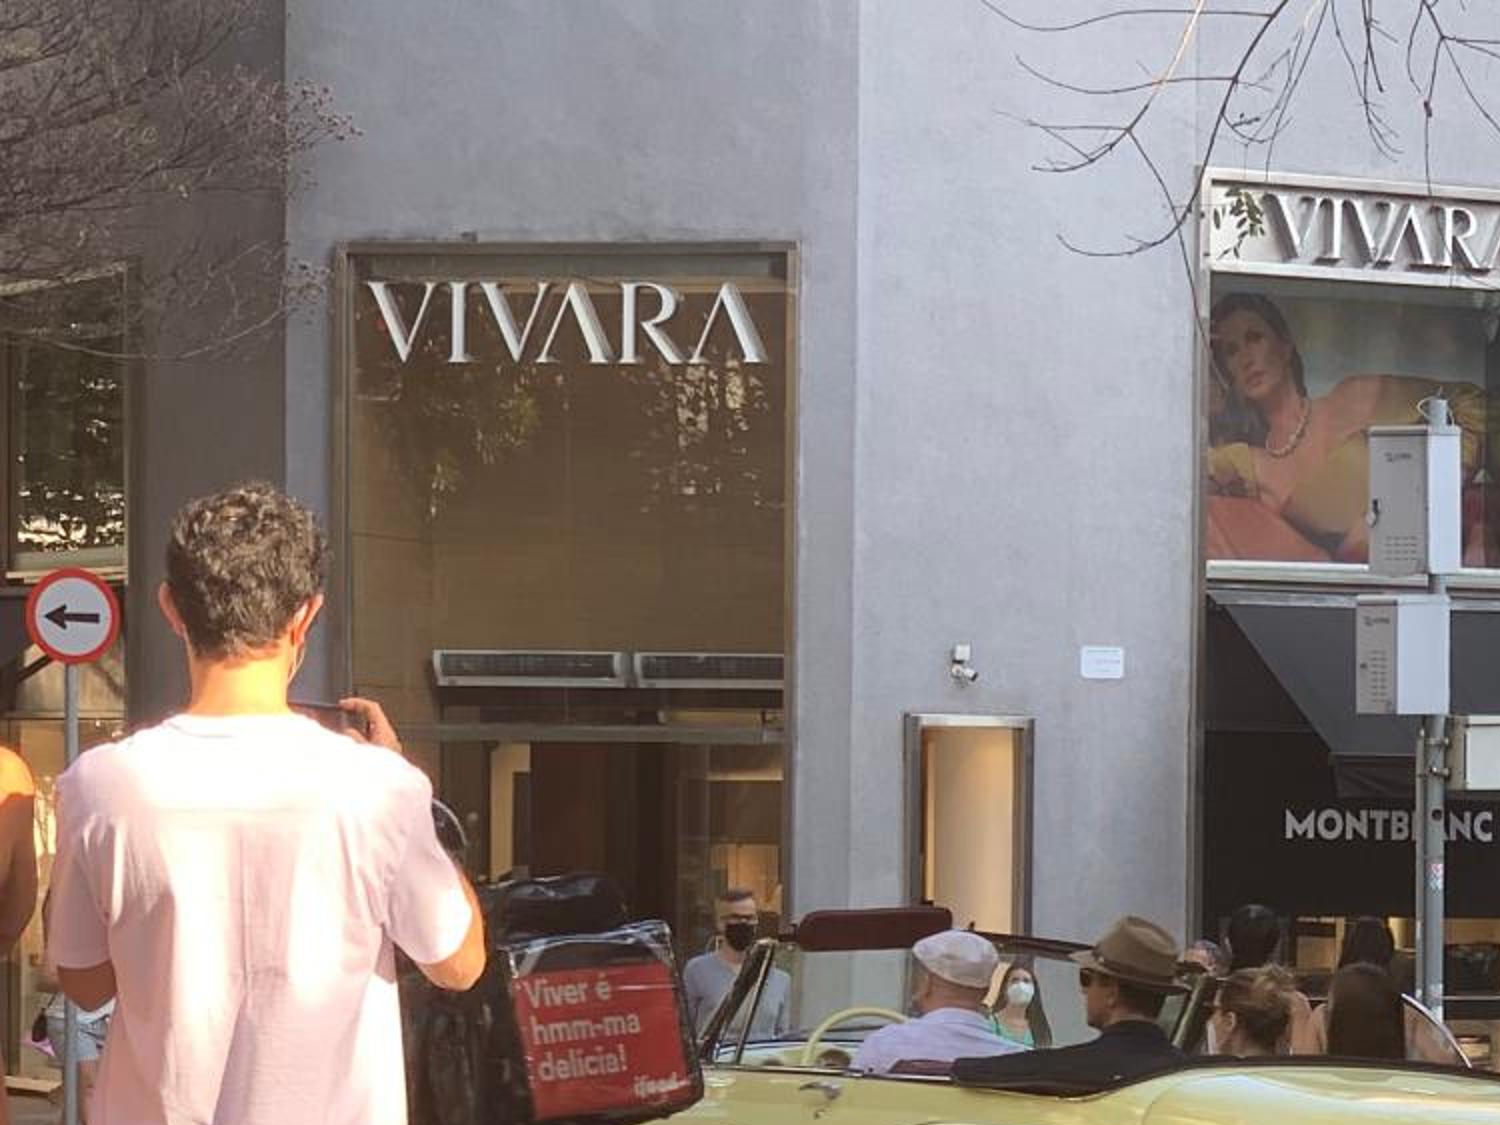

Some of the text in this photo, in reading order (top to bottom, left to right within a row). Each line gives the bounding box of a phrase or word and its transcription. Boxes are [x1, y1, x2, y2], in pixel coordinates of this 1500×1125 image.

[367, 280, 768, 363] VIVARA
[1285, 808, 1493, 843] MONTBNC
[523, 971, 612, 1009] Viver é
[529, 1013, 641, 1046] hmm-ma
